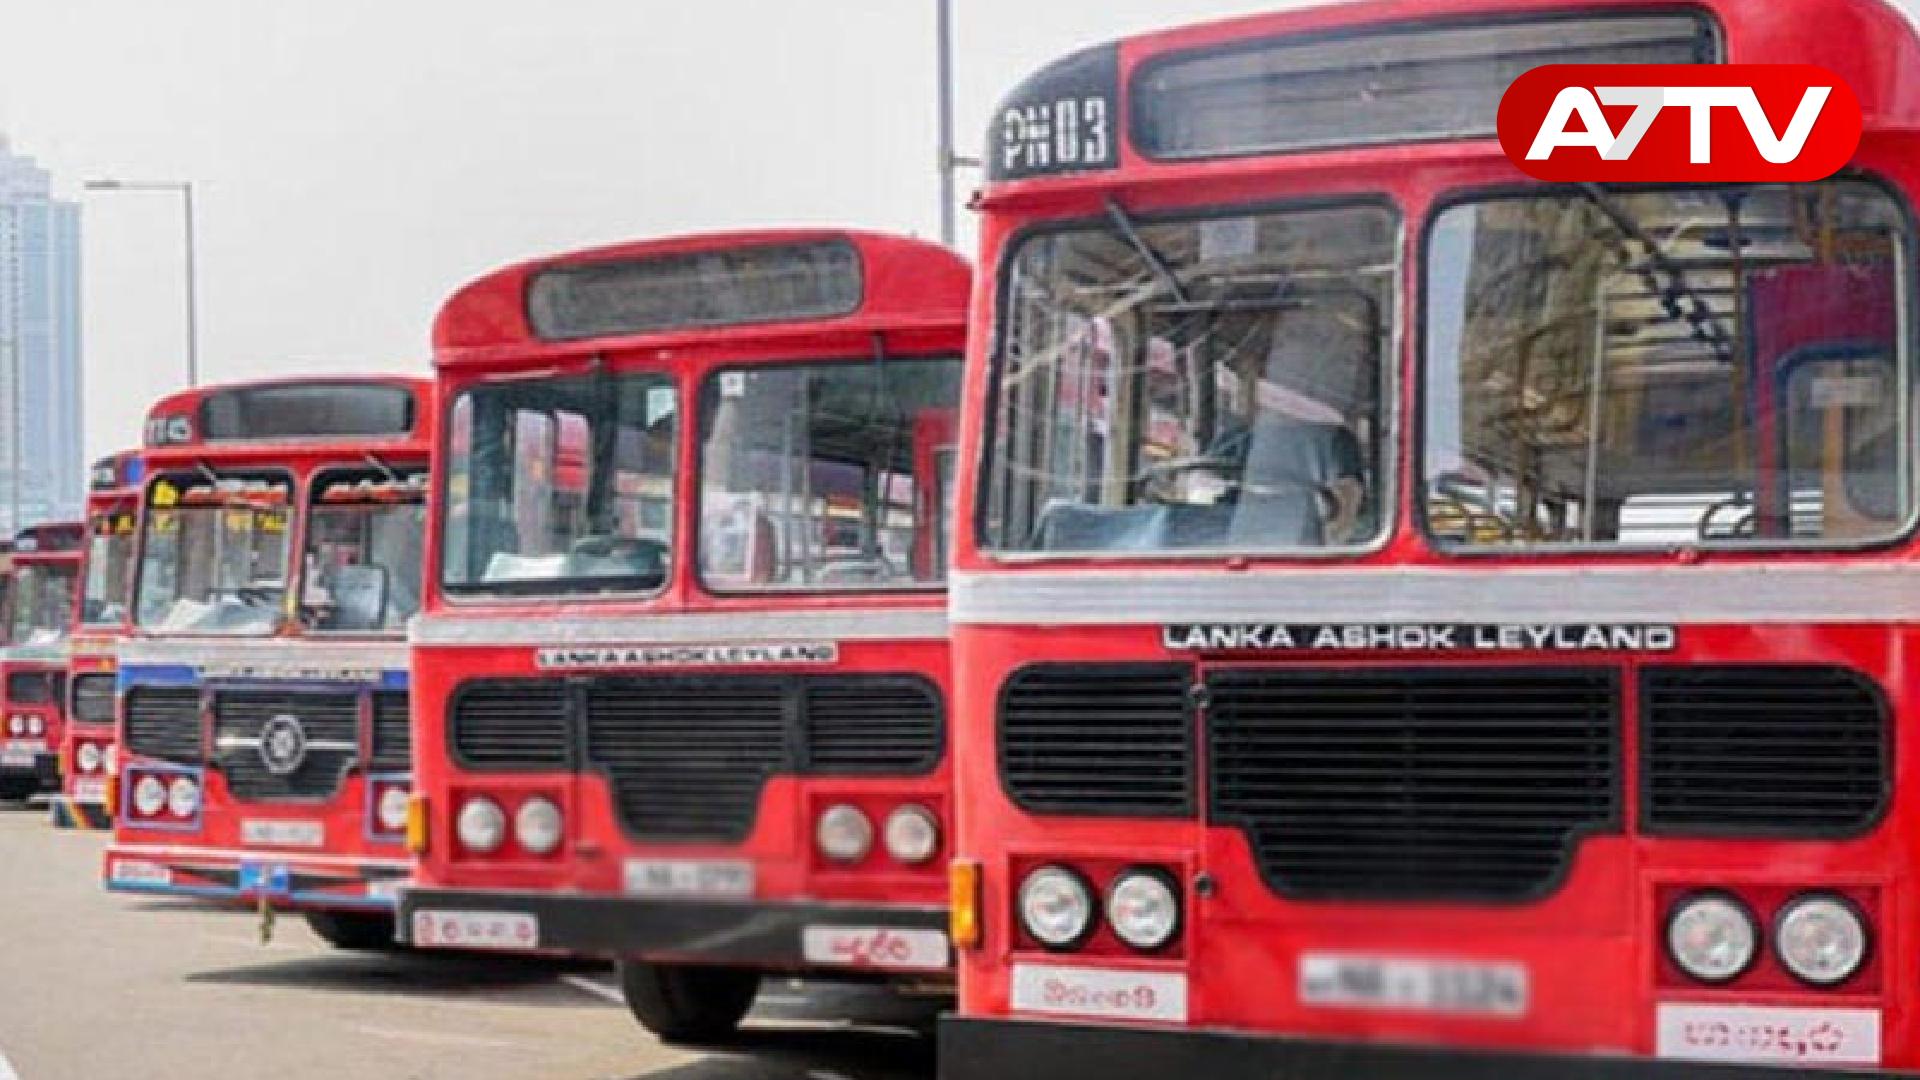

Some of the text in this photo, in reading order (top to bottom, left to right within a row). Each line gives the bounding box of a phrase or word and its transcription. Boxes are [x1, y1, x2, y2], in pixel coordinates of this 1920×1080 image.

[1163, 625, 1675, 649] LANKA ASHOK LEYLAND
